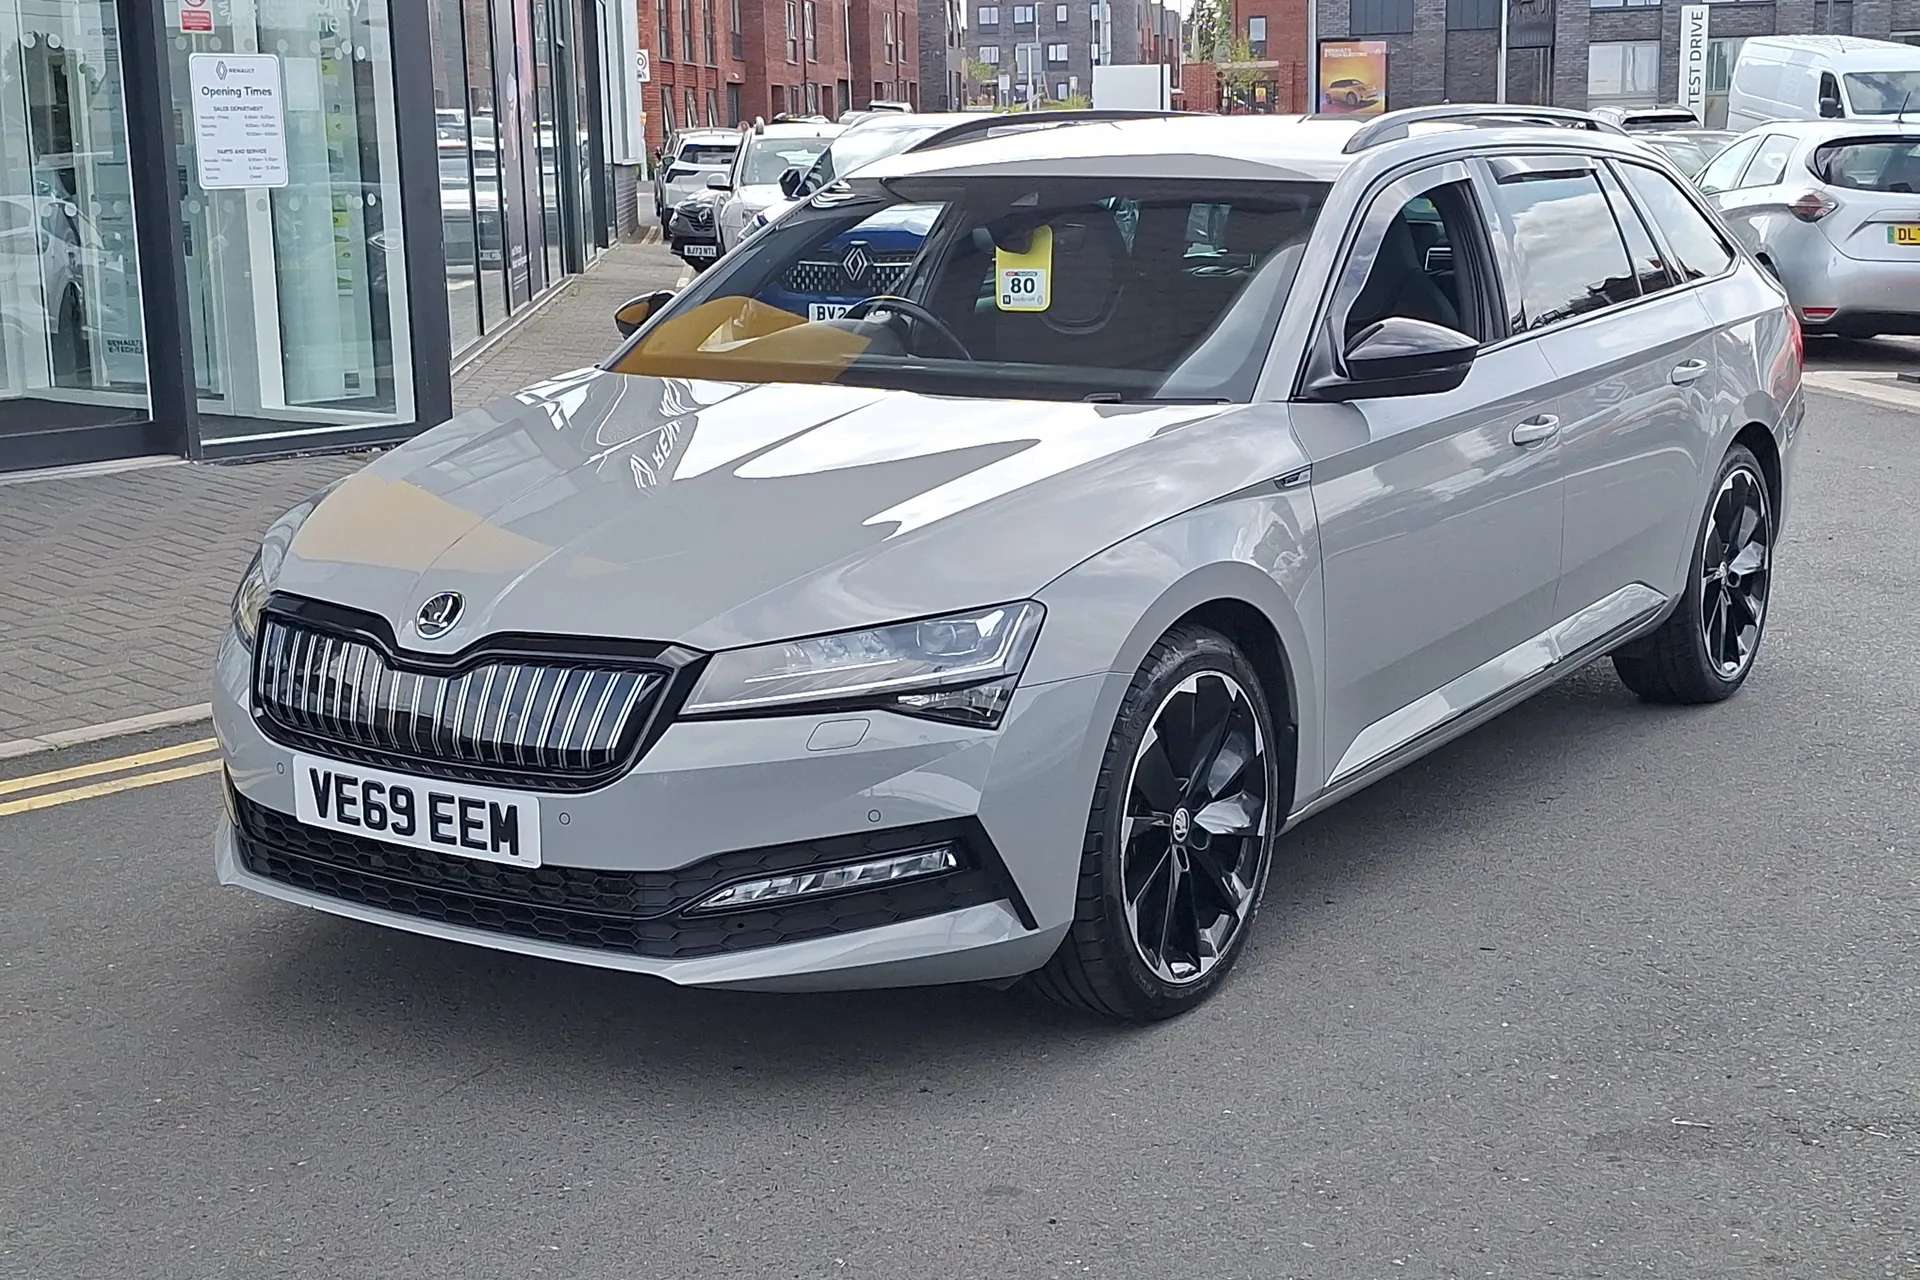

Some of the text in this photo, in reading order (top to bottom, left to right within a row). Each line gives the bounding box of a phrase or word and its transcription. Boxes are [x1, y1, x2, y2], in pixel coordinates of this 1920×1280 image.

[1688, 11, 1704, 107] TEST DRIVE
[201, 86, 272, 99] Opening Times
[1898, 227, 1920, 241] DL
[1010, 277, 1035, 293] 80
[309, 767, 519, 856] VE69 EEM
